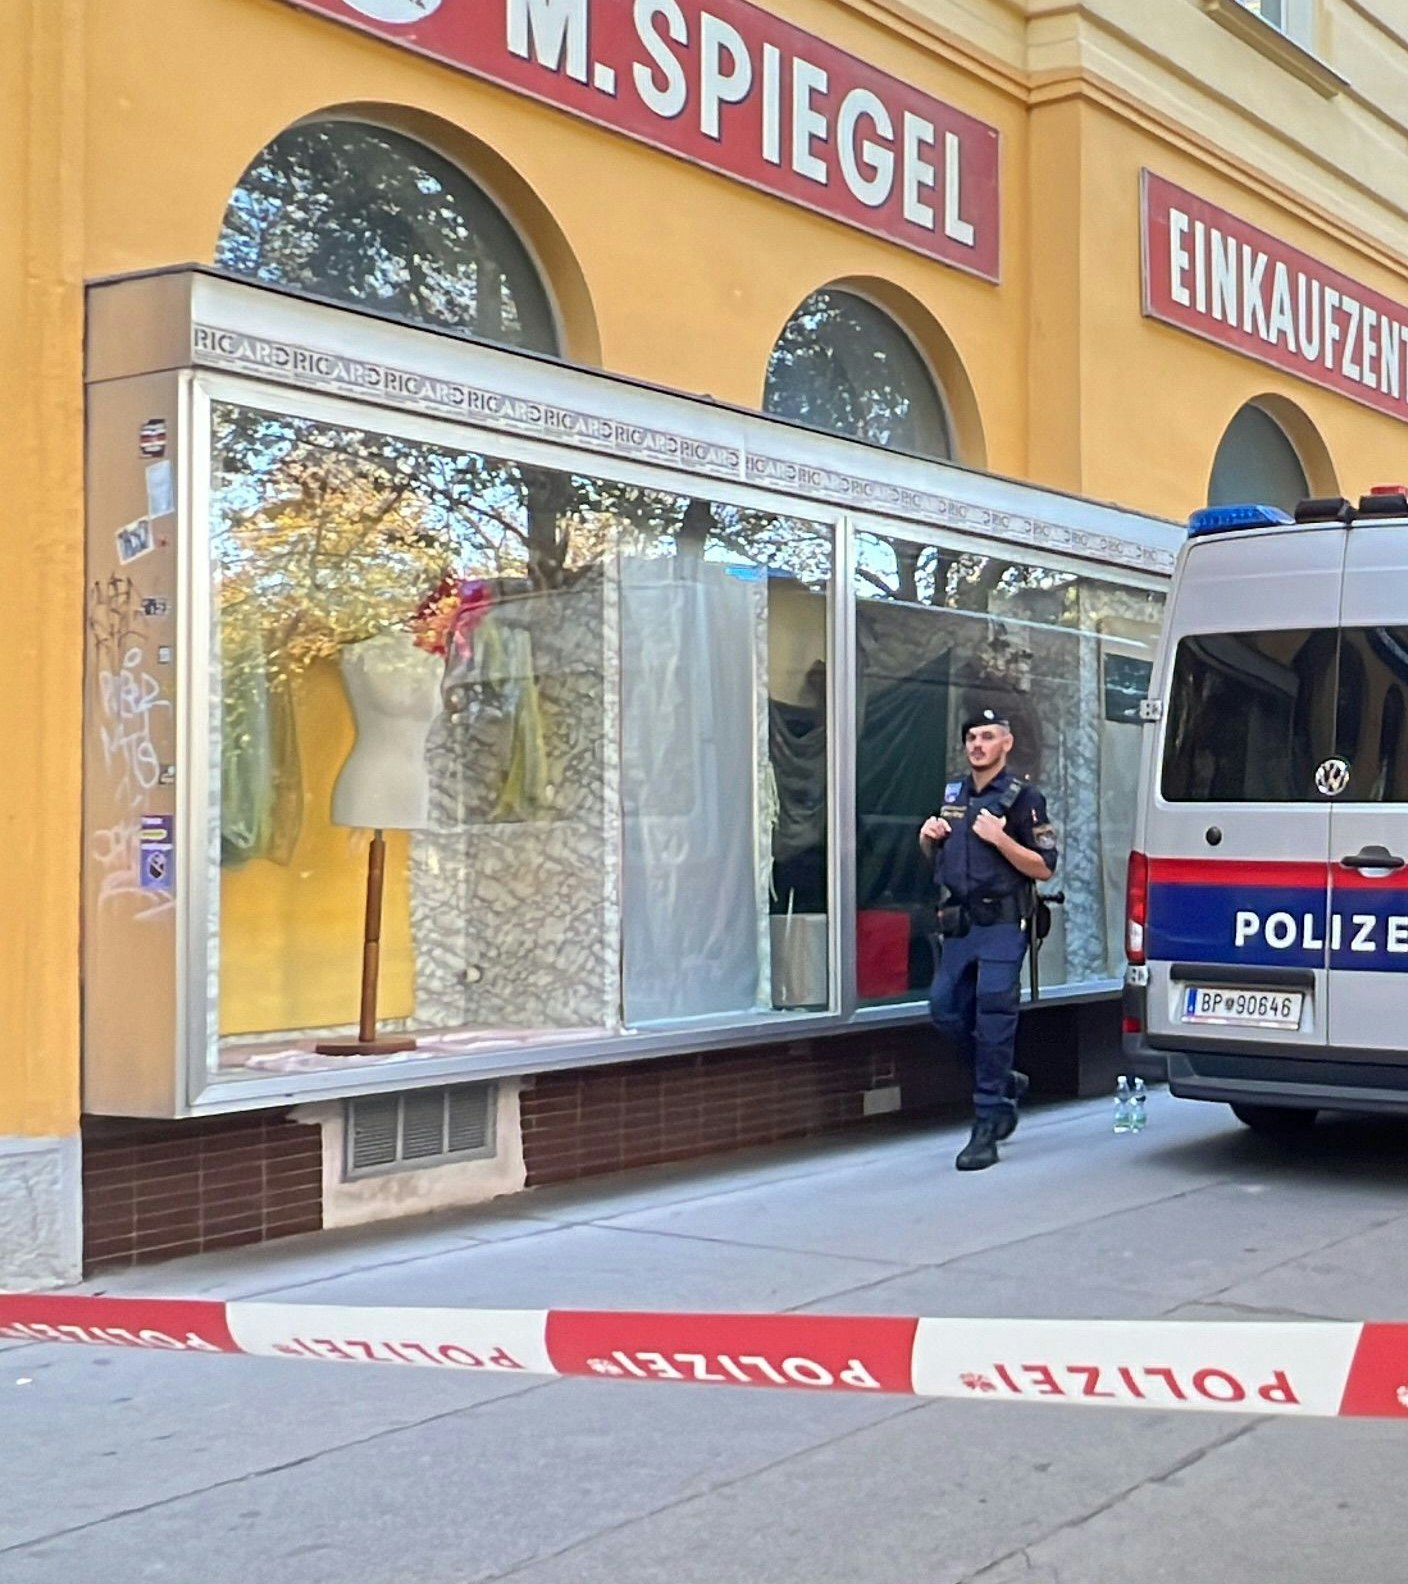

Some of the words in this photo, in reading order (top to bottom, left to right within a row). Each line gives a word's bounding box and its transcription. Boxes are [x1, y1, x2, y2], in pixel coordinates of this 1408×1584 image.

[292, 1337, 527, 1370] POLIZEI
[611, 1350, 881, 1389] POLIZEI
[994, 1361, 1302, 1405] POLIZEI
